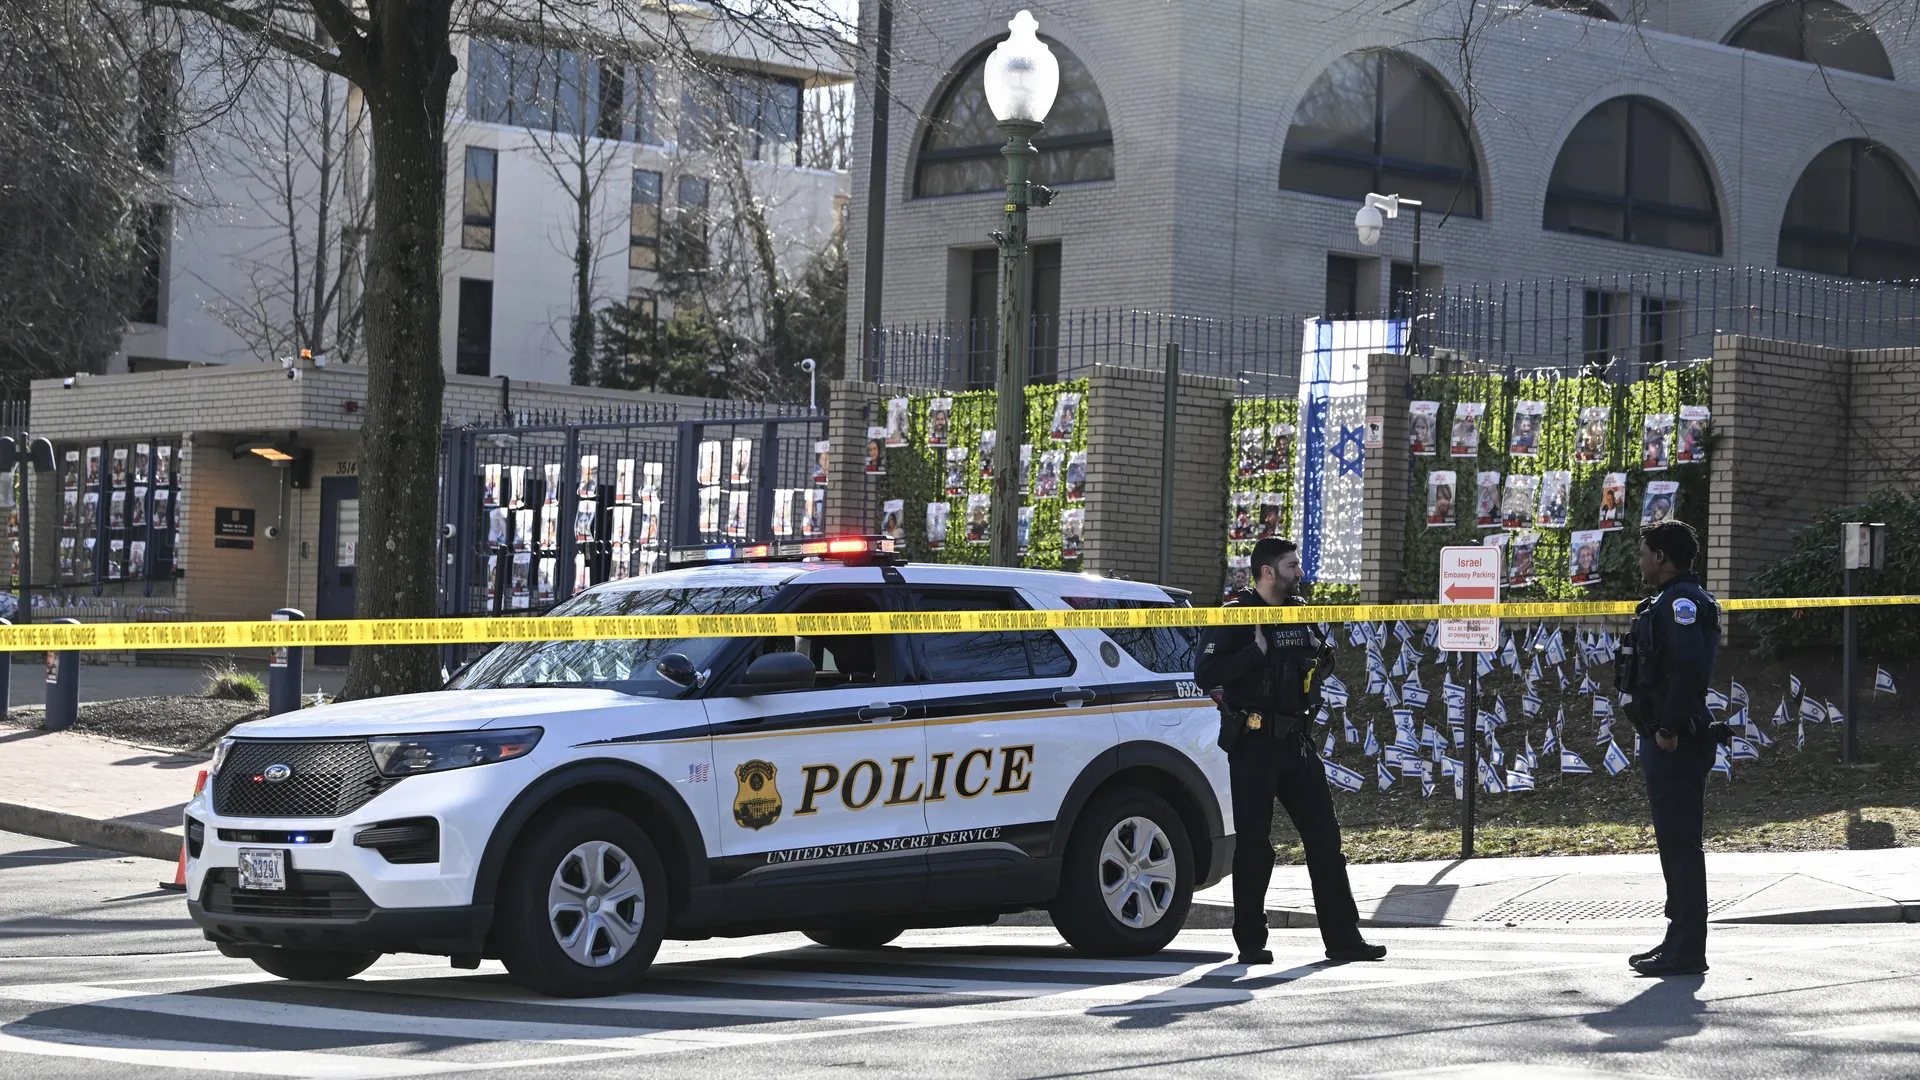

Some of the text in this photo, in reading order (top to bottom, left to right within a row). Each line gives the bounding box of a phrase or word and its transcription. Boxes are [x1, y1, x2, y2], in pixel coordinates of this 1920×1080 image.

[336, 461, 357, 474] 3514
[1458, 558, 1482, 567] Israel
[1472, 572, 1495, 580] Parking
[793, 744, 1034, 816] POLICE
[766, 827, 1001, 864] UNITED STATES SECRET SERVICE
